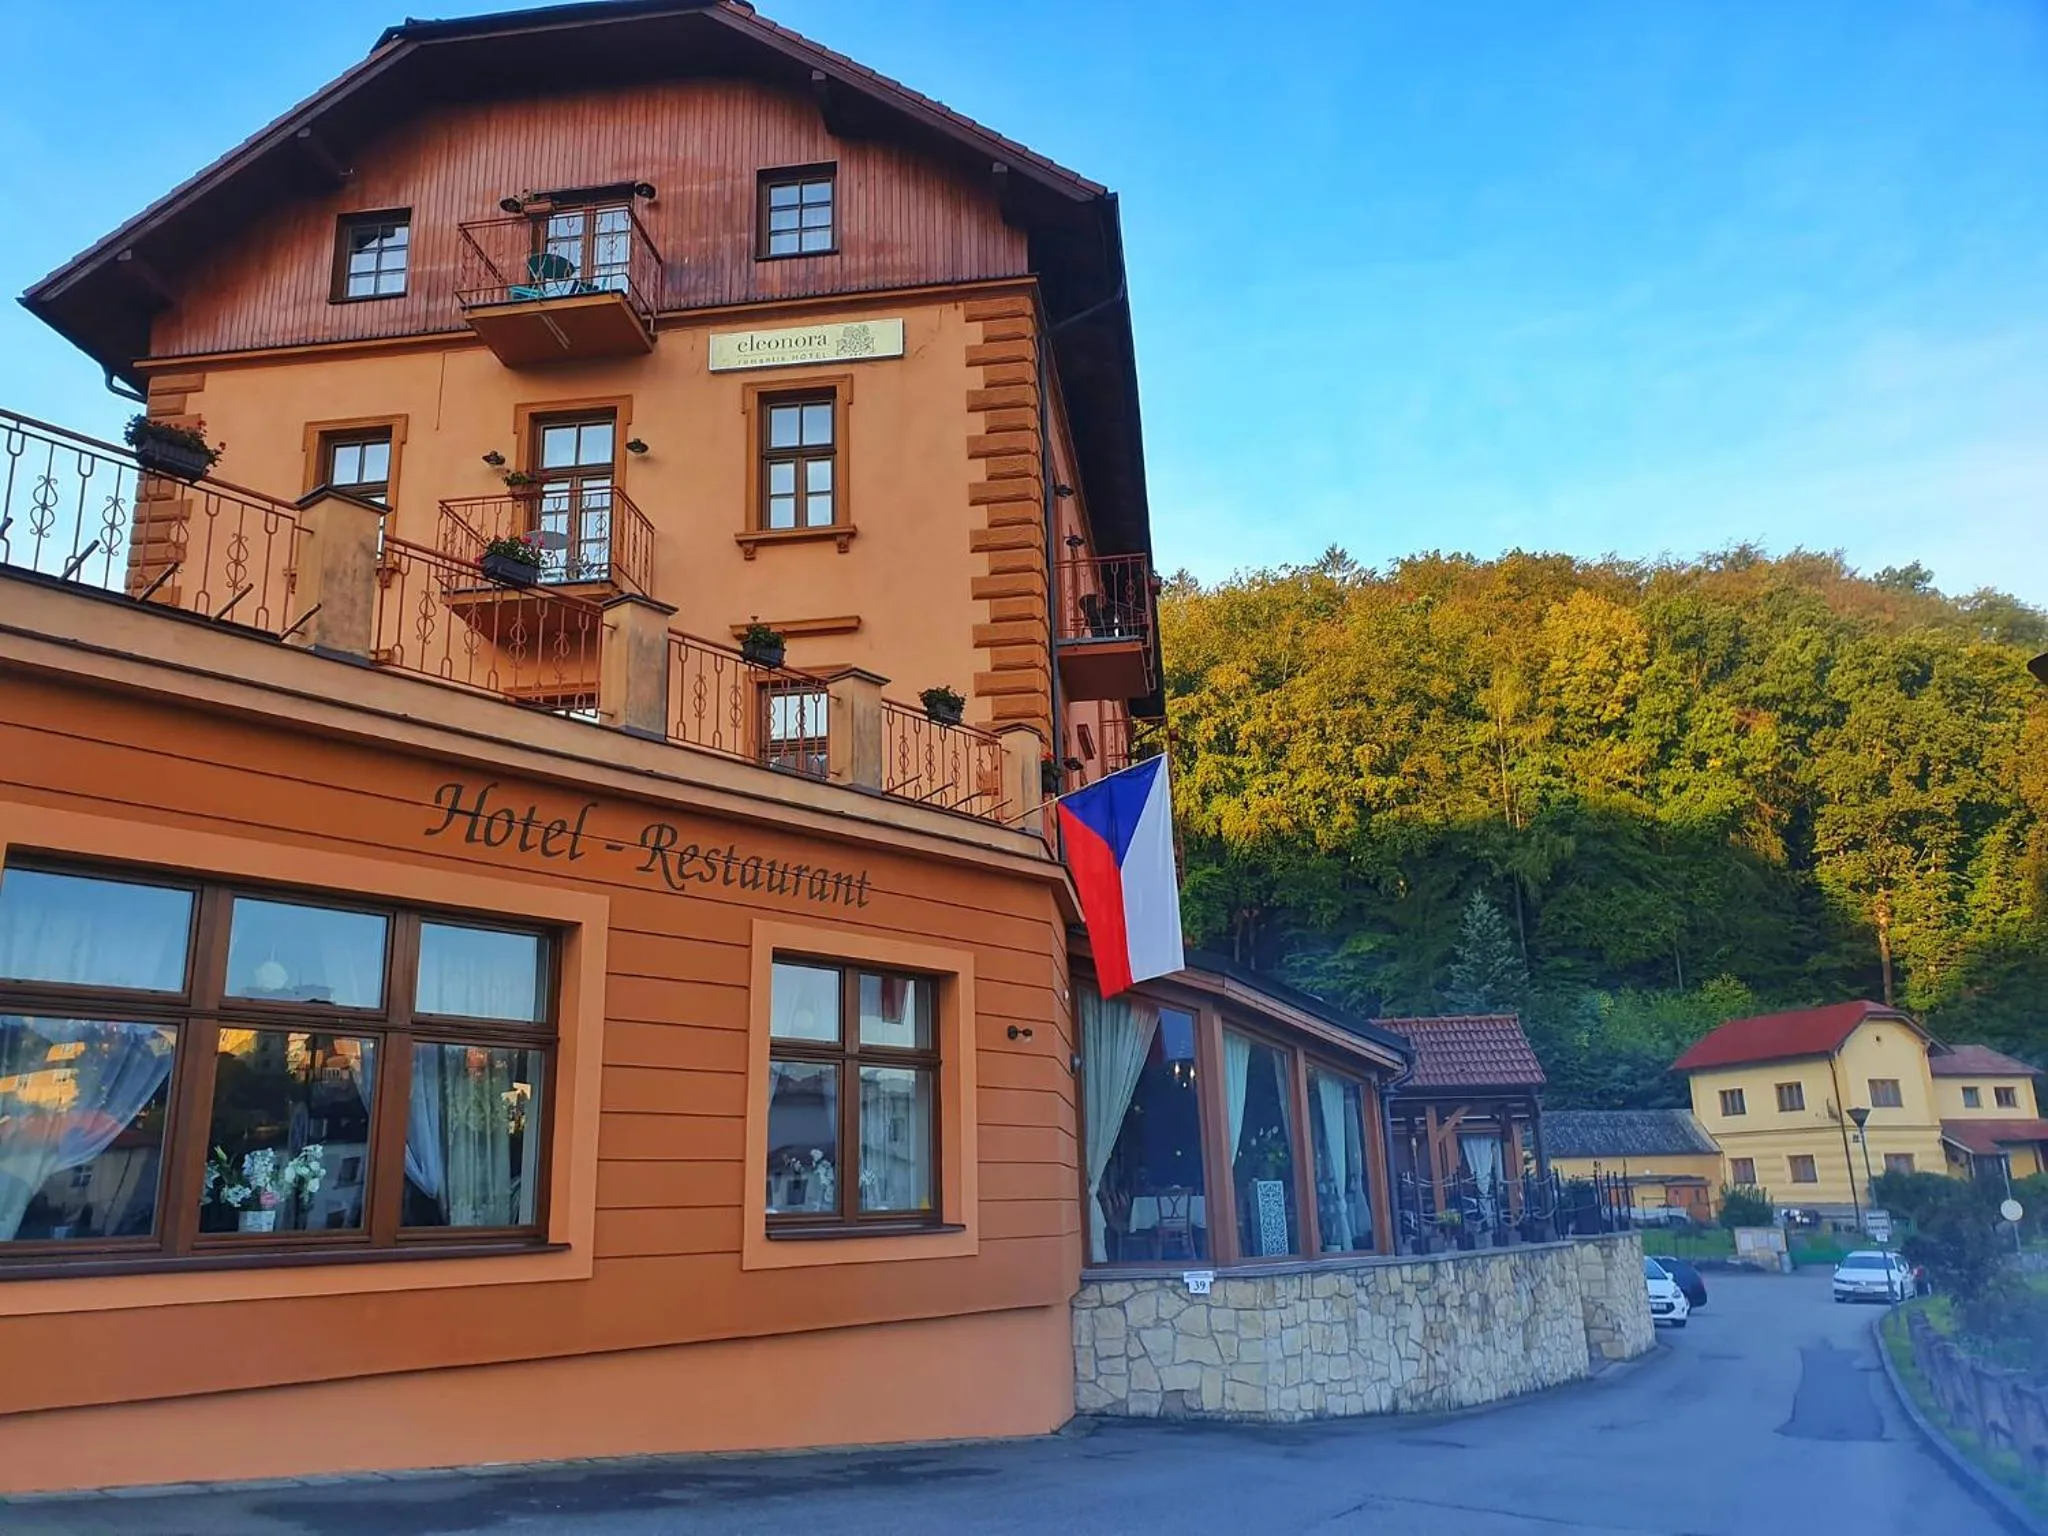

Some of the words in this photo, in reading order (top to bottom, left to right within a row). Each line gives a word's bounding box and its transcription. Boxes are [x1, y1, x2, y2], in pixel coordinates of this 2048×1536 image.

[737, 334, 827, 353] eleonora
[424, 782, 597, 861] Hotel
[636, 822, 871, 908] Restaurant
[1193, 1279, 1206, 1291] 39
